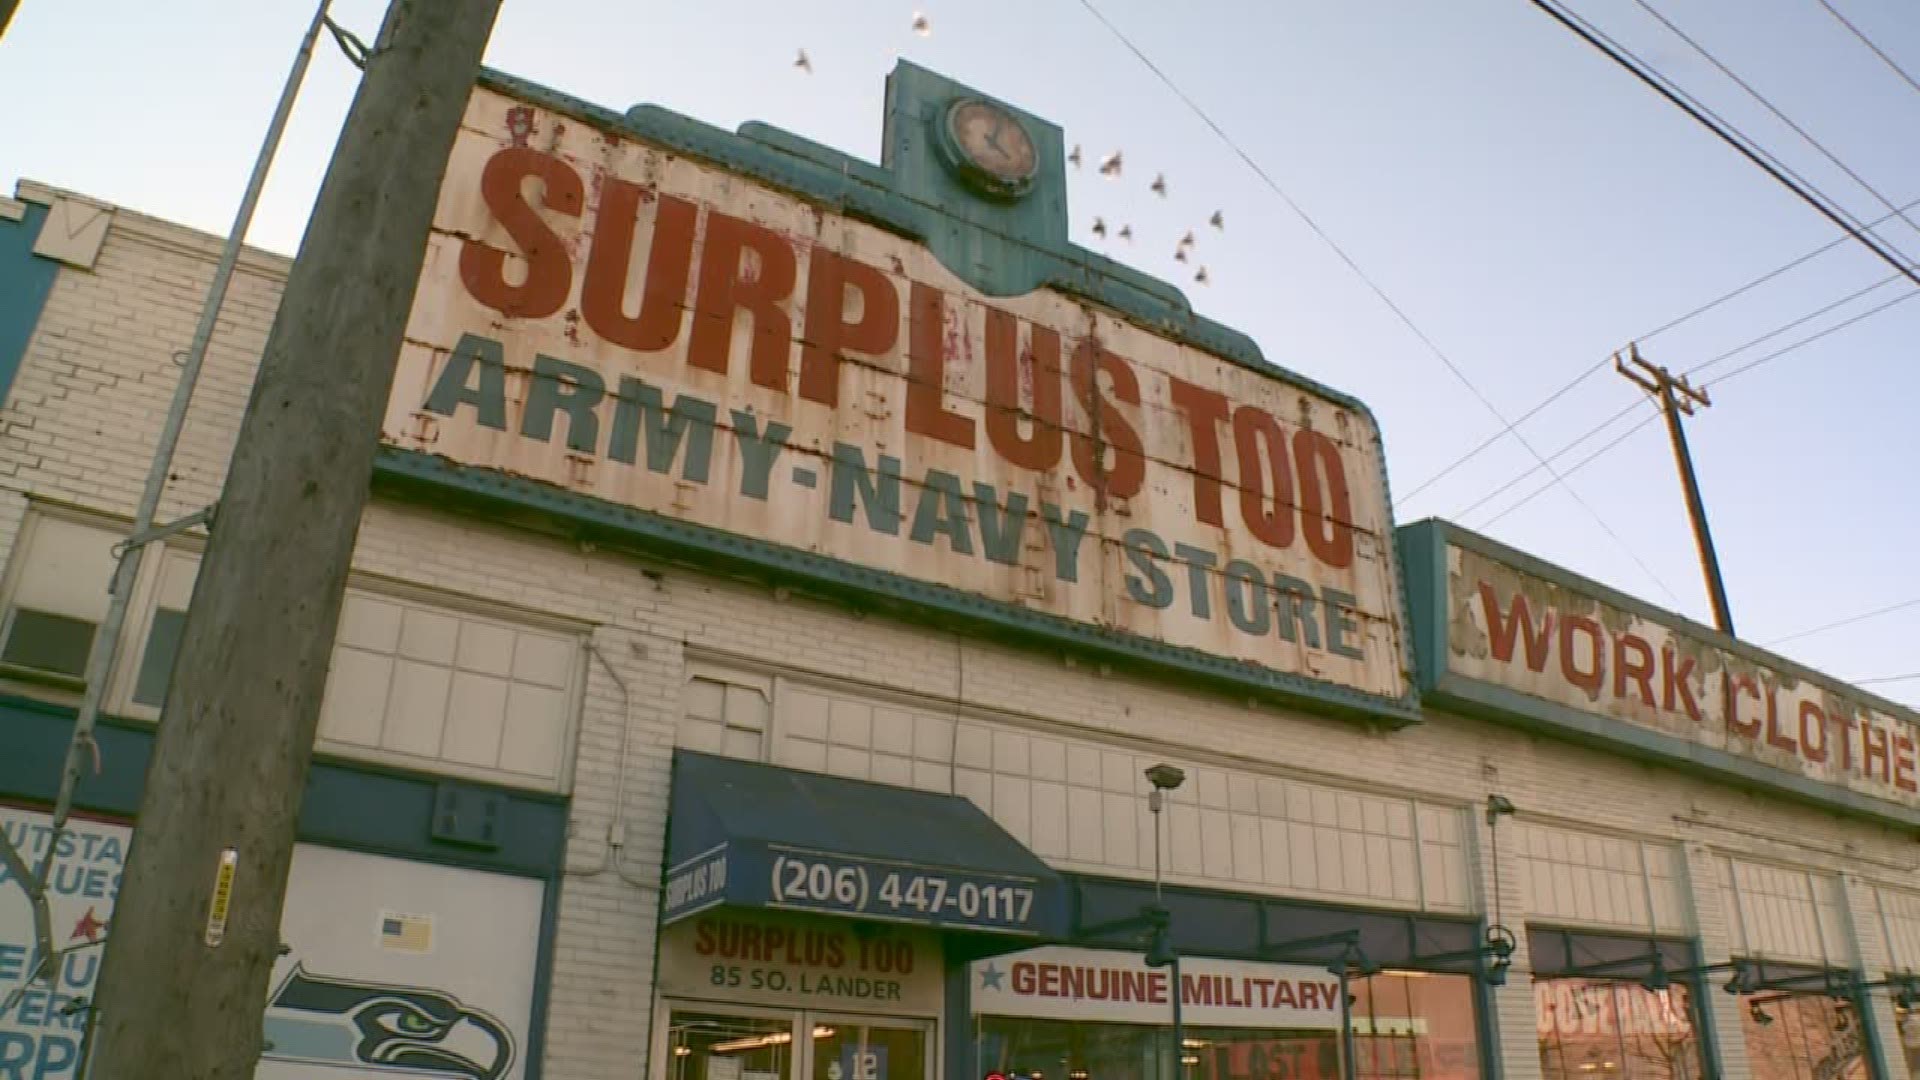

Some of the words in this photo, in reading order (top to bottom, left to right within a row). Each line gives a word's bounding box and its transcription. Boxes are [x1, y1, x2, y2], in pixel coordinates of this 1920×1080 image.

[458, 147, 1146, 500] SURPLUS
[1170, 376, 1354, 569] TOO
[422, 332, 1090, 584] ARMY-NAVY
[1122, 527, 1365, 661] STORE
[1477, 579, 1702, 722] WORK
[1727, 670, 1918, 794] CLOTHE
[771, 856, 870, 912] (206)
[878, 872, 1034, 923] 447-0117
[695, 920, 847, 969] SURPLUS
[858, 933, 914, 975] TOO
[710, 965, 742, 987] 85
[750, 967, 793, 992] SO.
[800, 972, 901, 1001] LANDER
[1011, 961, 1168, 1004] GENUINE
[1181, 974, 1339, 1010] MILITARY
